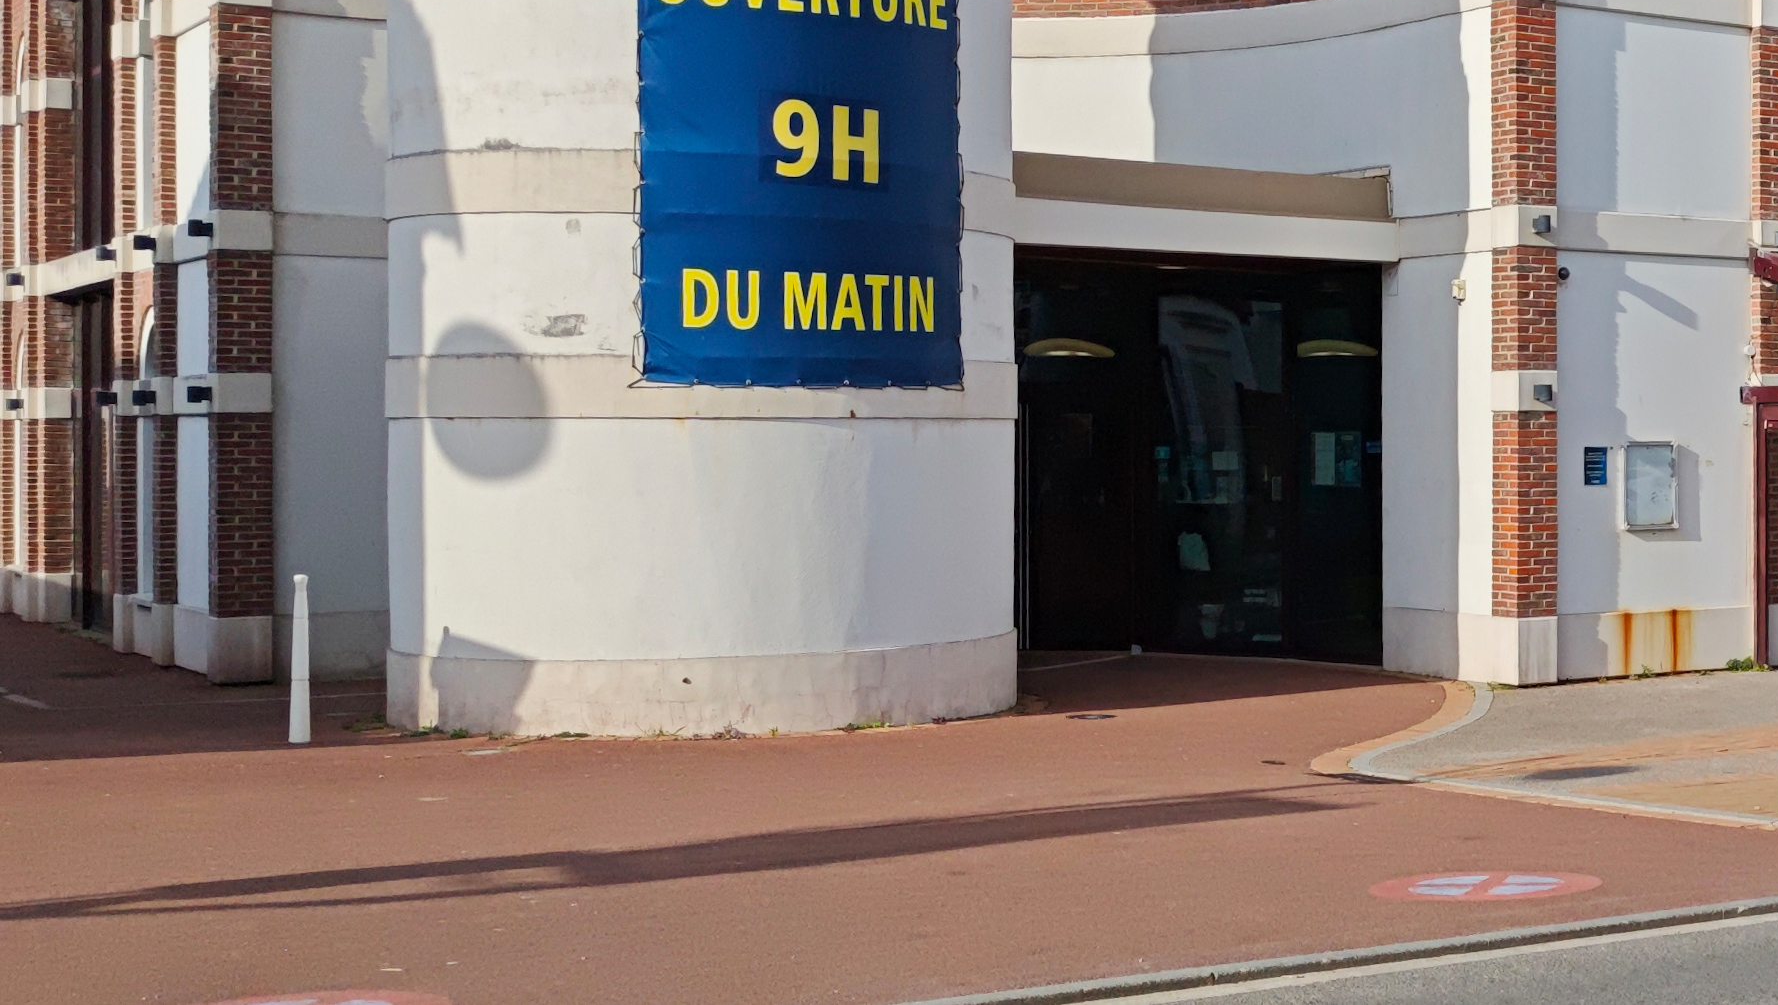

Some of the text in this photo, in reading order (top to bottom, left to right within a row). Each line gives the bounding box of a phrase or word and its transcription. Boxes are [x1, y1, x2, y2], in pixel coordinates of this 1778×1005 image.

[771, 99, 881, 185] 9H
[682, 269, 936, 333] DU MATIN
